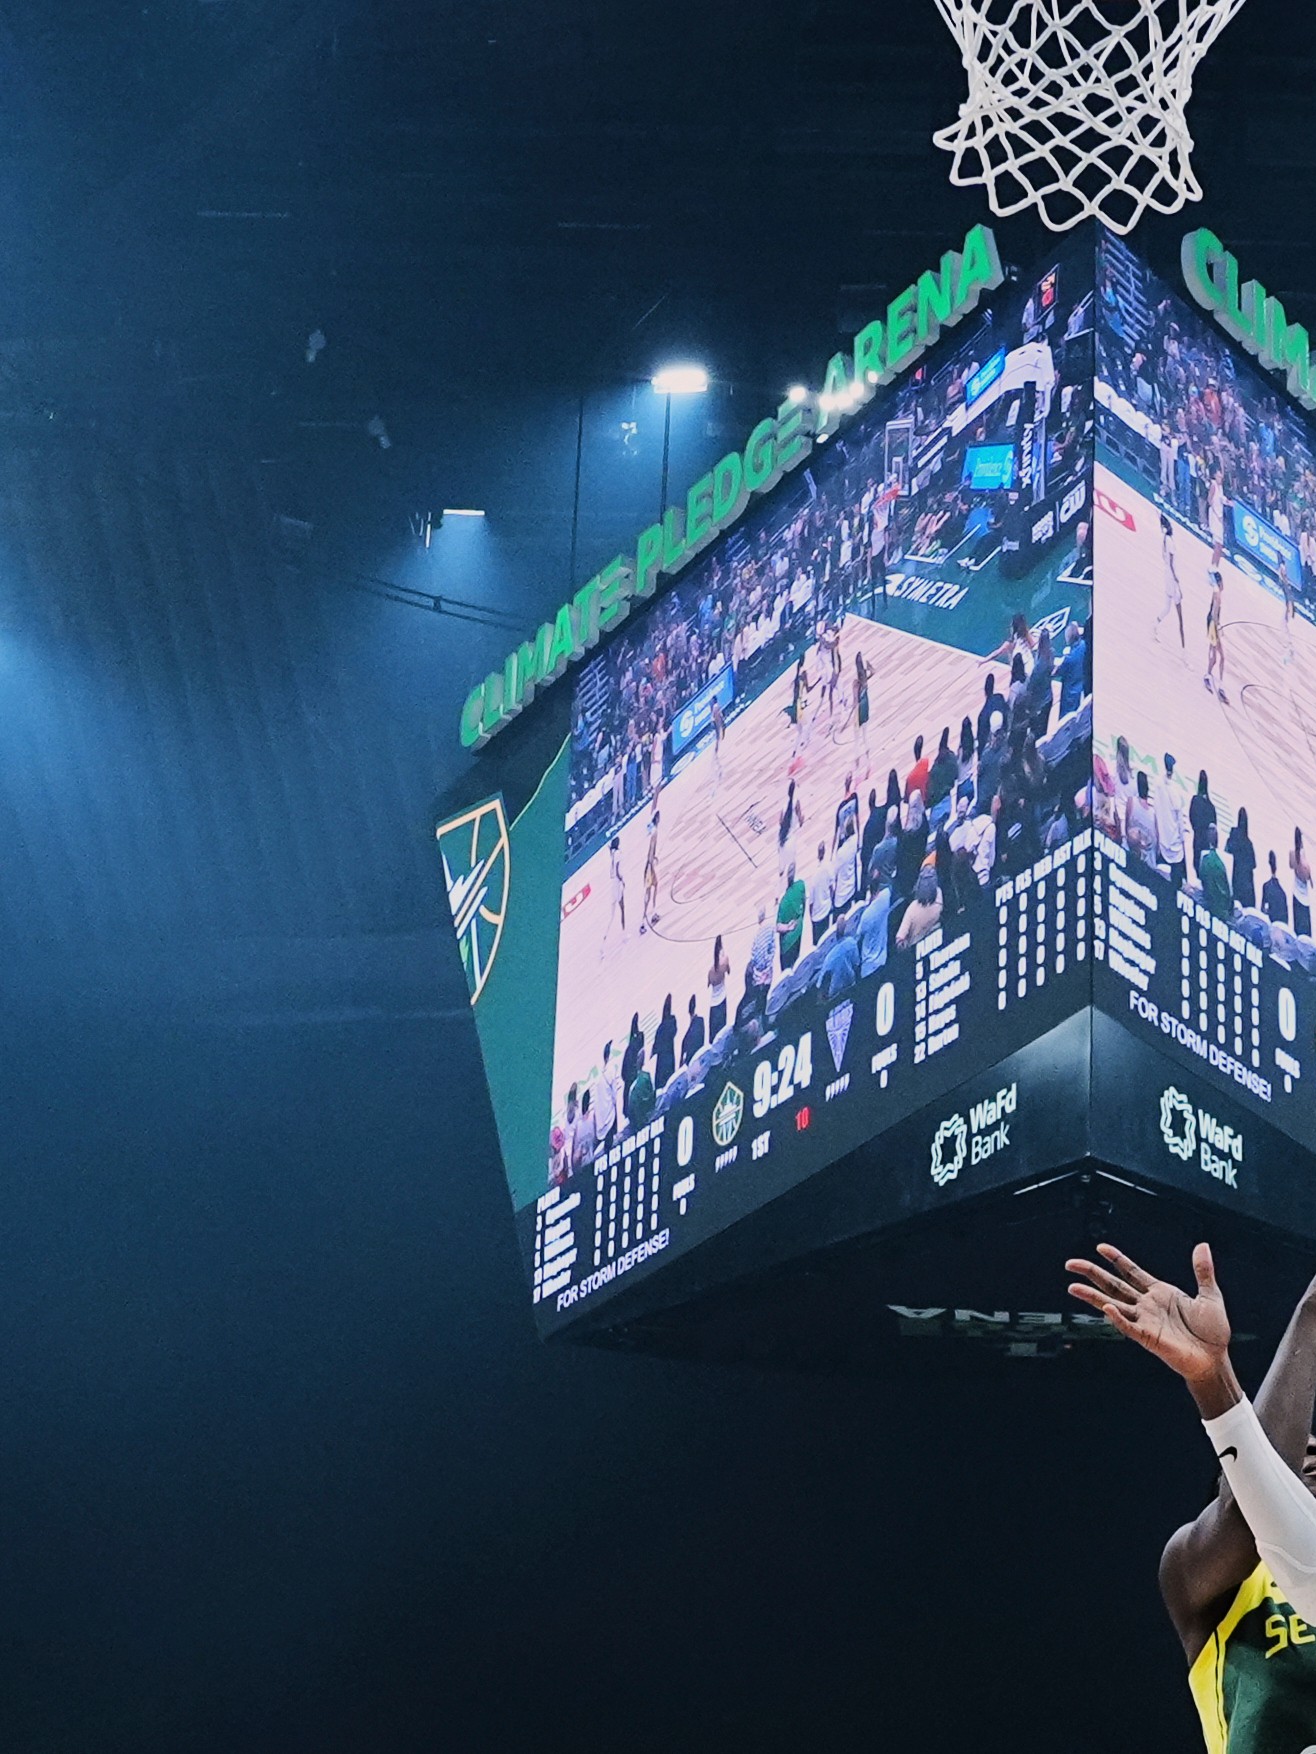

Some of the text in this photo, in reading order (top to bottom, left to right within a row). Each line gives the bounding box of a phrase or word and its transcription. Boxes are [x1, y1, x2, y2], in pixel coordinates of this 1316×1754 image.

[460, 223, 1004, 748] CLIMATE PLEDGE ARENA
[876, 982, 895, 1036] 0
[1278, 987, 1296, 1042] 0
[1129, 990, 1273, 1103] FOR STORM DEFENSE!
[753, 1031, 813, 1118] 9:24
[969, 1083, 1017, 1134] WaFd
[1197, 1108, 1243, 1162] WaFd
[677, 1116, 694, 1167] 0
[751, 1130, 771, 1160] 1ST
[971, 1122, 1010, 1166] Bank
[1200, 1141, 1238, 1189] Bank
[557, 1285, 579, 1312] FOR
[579, 1261, 616, 1298] STORM
[617, 1228, 670, 1275] DEFENSE!
